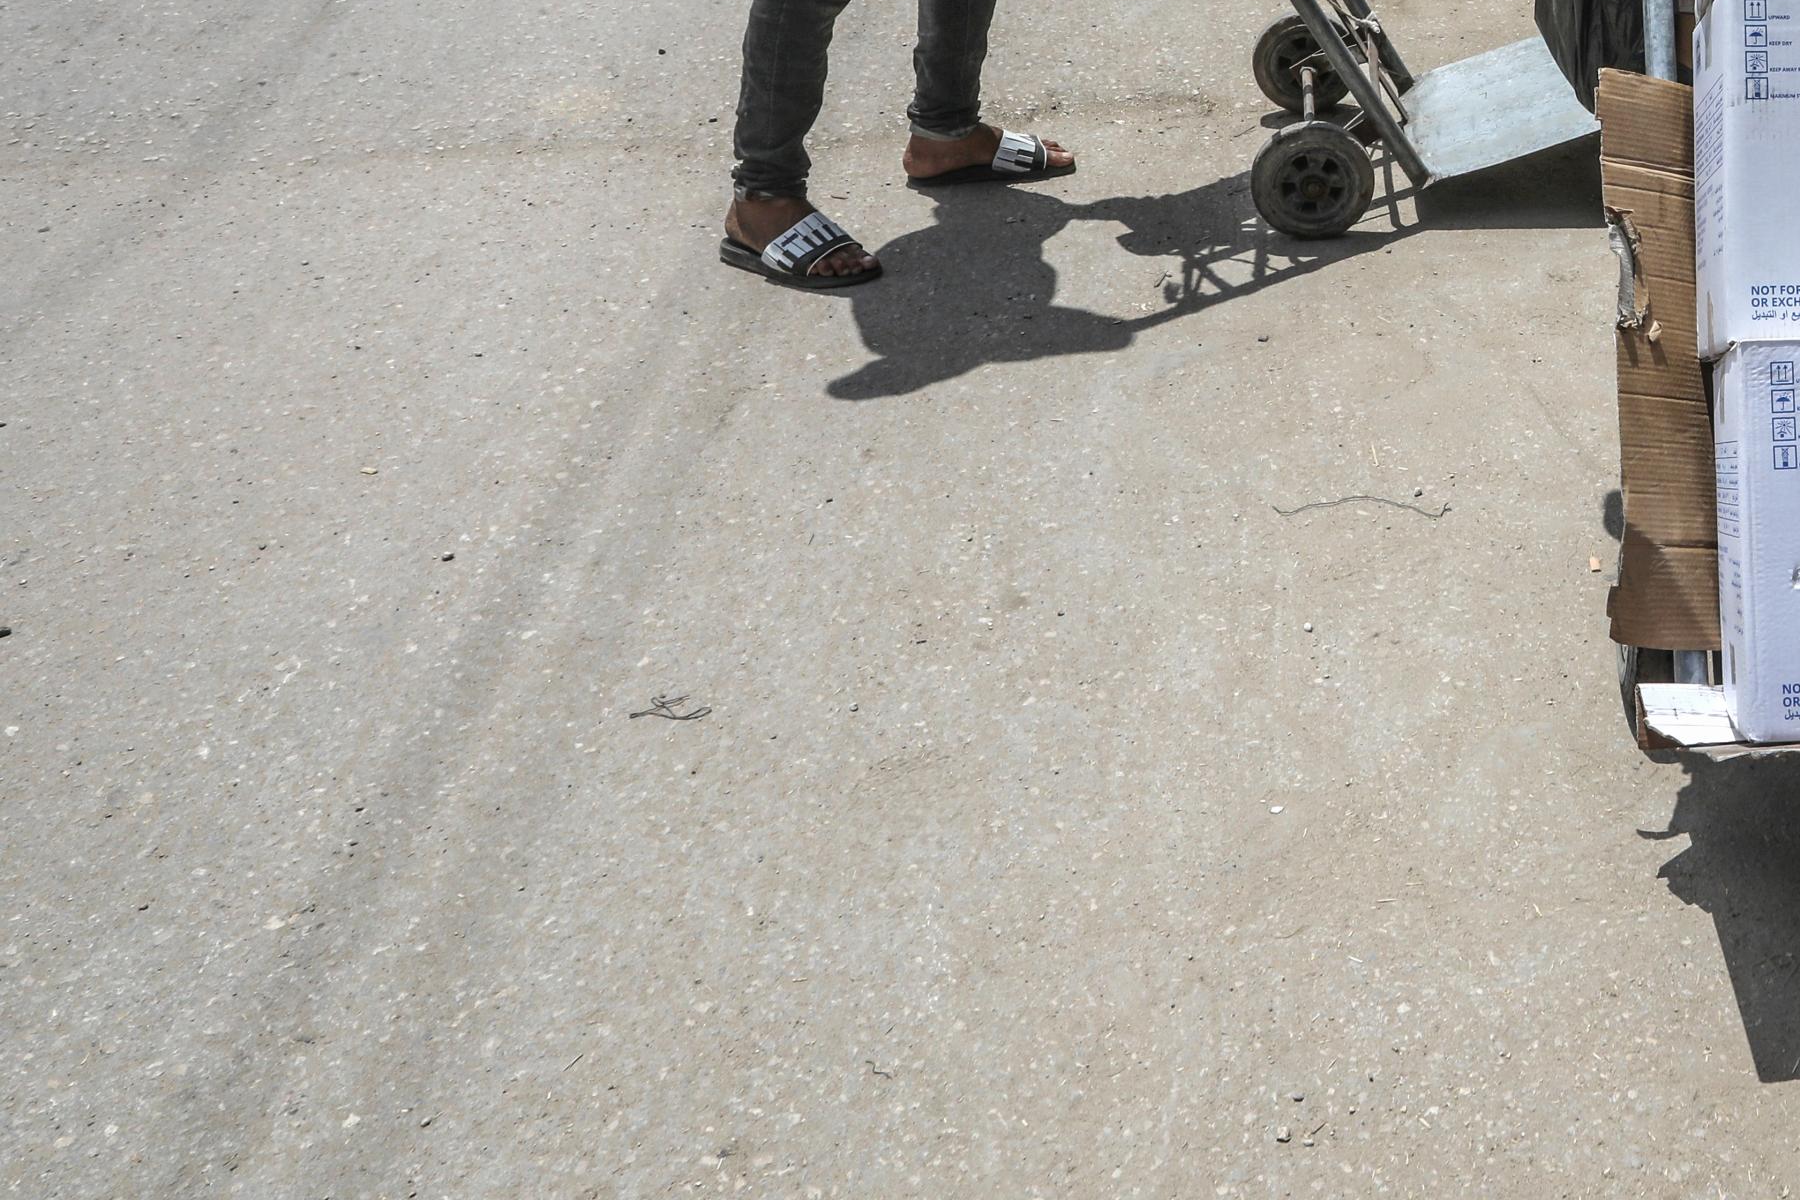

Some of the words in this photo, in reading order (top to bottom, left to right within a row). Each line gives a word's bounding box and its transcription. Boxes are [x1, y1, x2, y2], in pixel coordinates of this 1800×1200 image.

[1751, 285, 1776, 295] NOT
[1751, 297, 1768, 307] OR
[1783, 696, 1800, 707] OR
